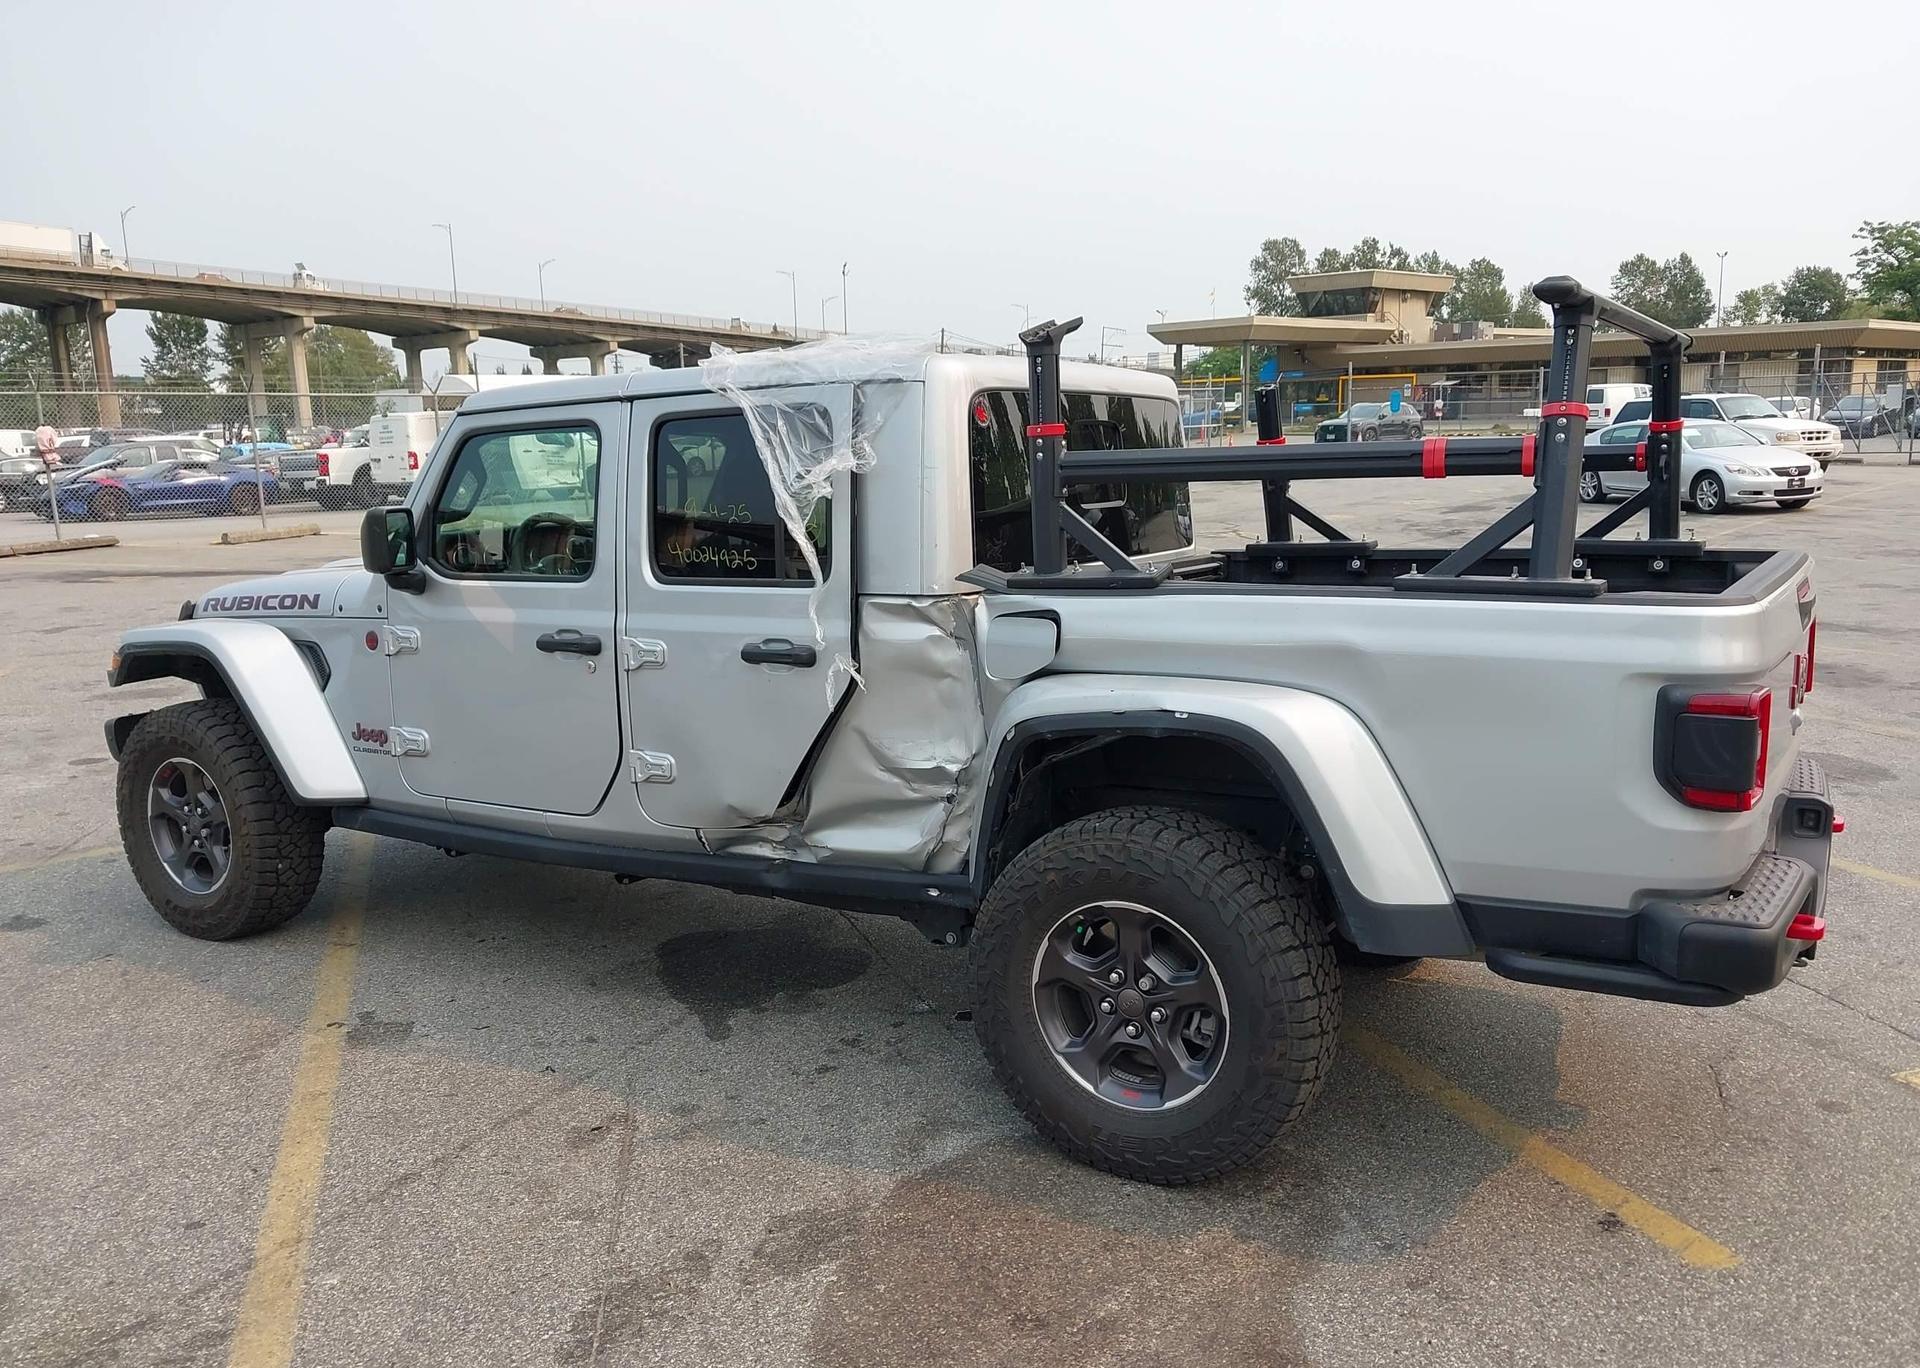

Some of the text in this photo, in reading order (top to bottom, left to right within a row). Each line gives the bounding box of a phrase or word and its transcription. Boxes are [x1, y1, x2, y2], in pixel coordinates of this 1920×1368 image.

[684, 497, 752, 524] 9-4-25
[667, 542, 758, 571] 40024925
[203, 593, 321, 612] RUBICON
[352, 722, 388, 747] Jeep
